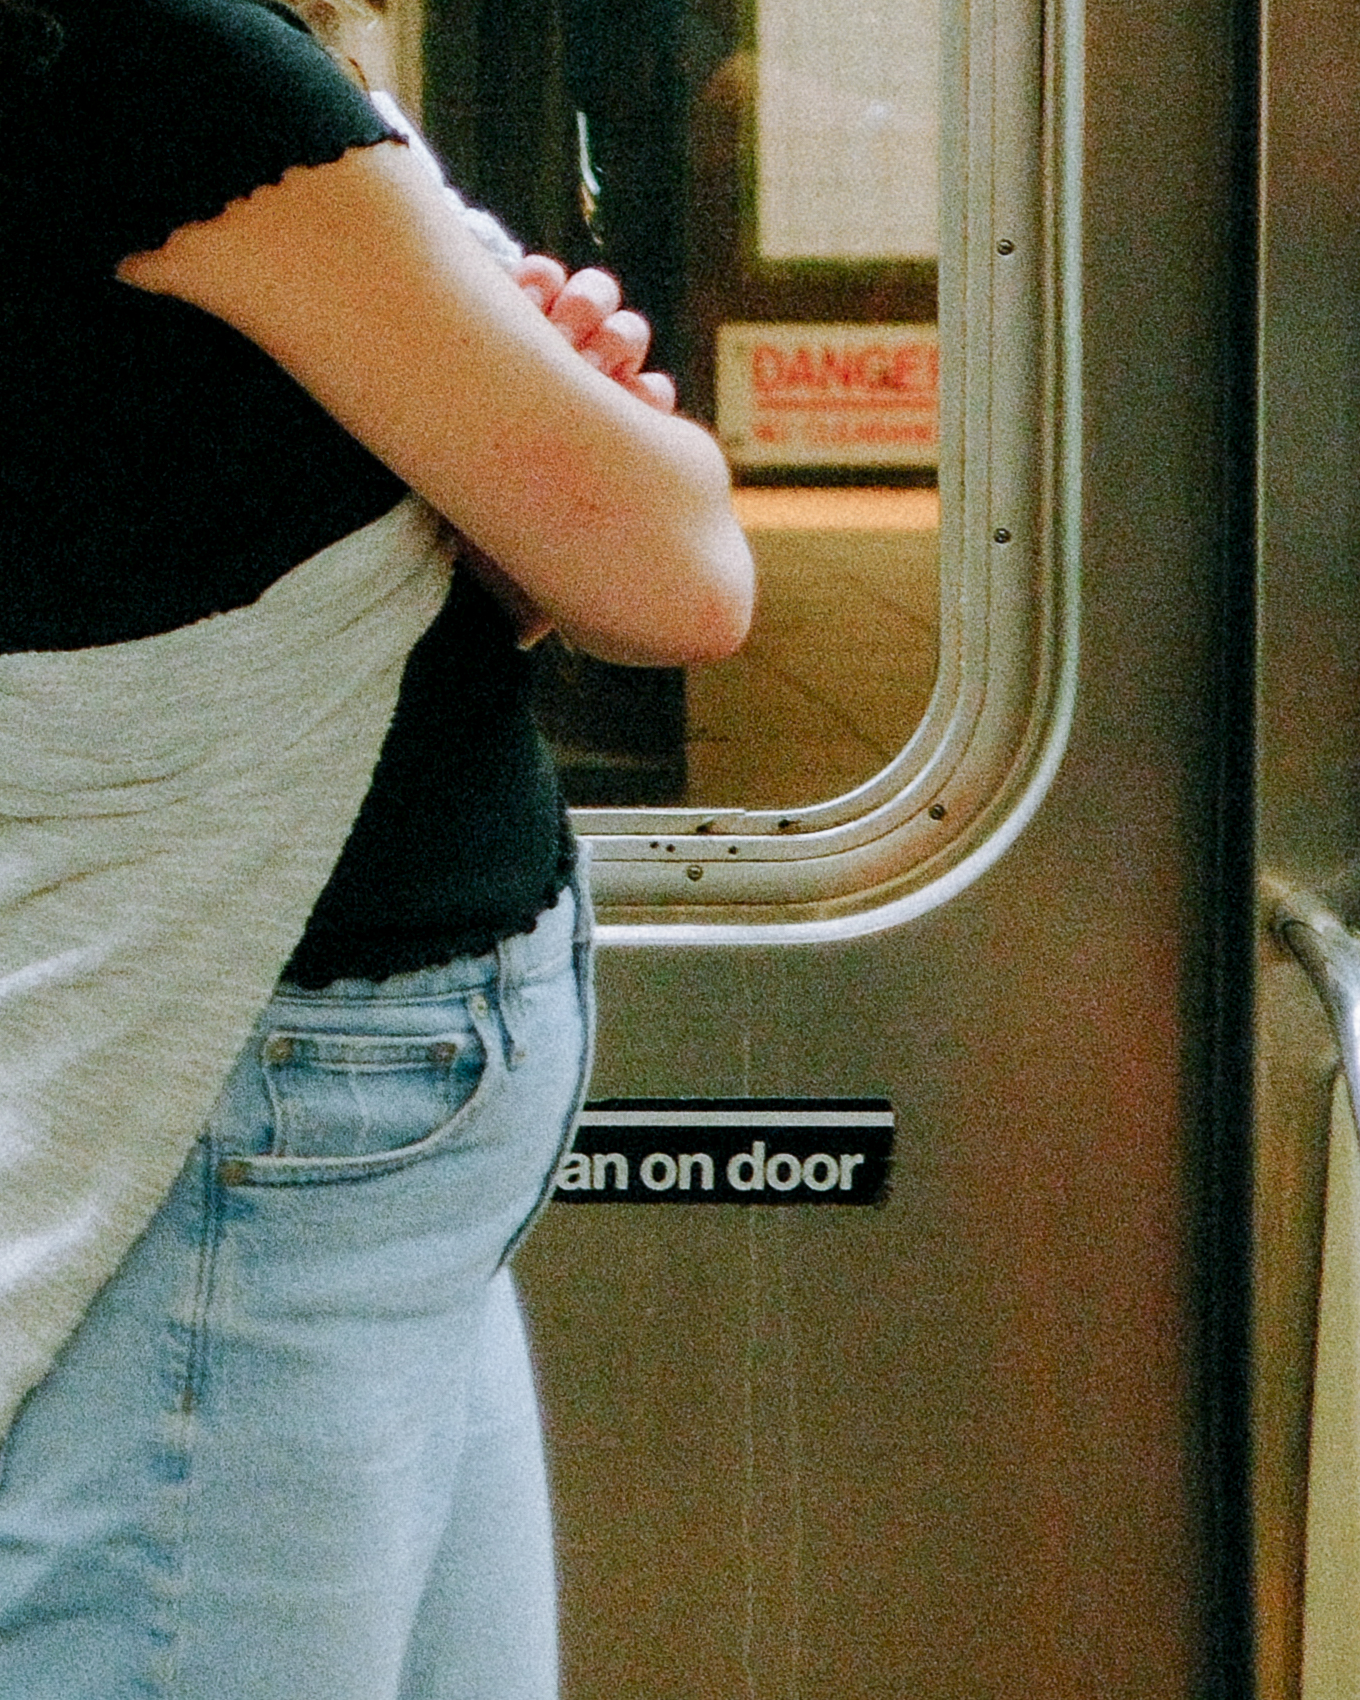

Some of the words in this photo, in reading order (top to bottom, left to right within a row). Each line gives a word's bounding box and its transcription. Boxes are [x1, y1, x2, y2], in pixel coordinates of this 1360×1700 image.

[556, 1151, 629, 1191] an
[639, 1152, 715, 1192] on
[725, 1139, 865, 1192] door
